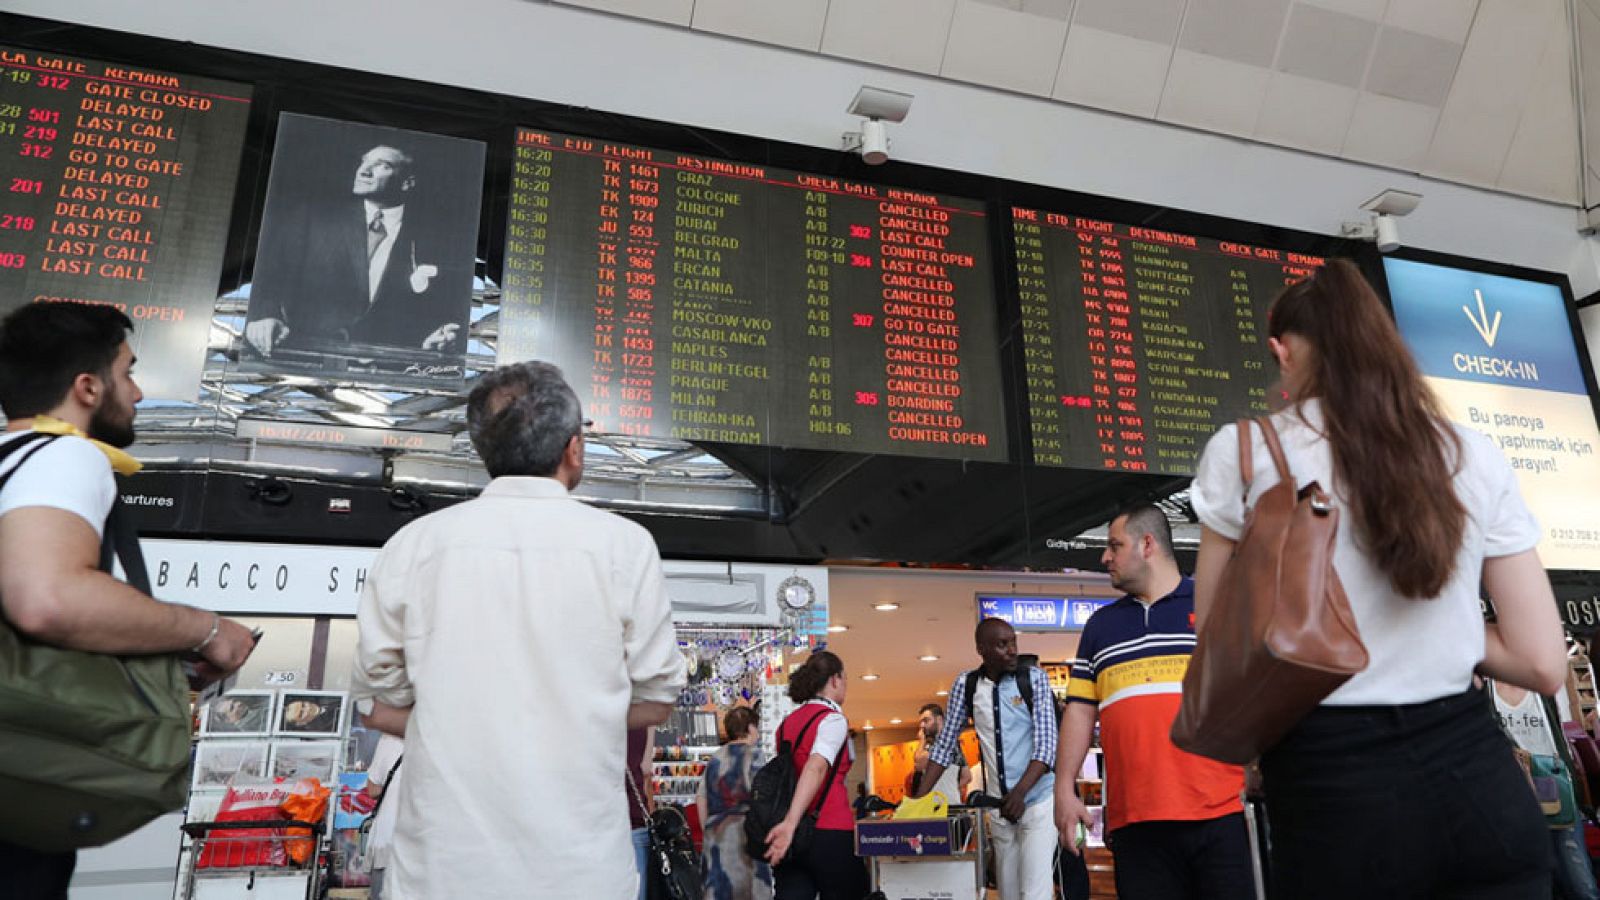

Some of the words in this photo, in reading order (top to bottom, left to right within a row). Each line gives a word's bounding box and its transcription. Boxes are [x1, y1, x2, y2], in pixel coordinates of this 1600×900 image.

[37, 74, 71, 90] 312
[85, 81, 134, 99] GATE
[140, 90, 212, 111] CLOSED
[80, 98, 164, 122] DELAYED
[23, 125, 58, 141] 219
[72, 132, 156, 155] DELAYED
[76, 115, 125, 133] LAST
[131, 124, 177, 141] CALL
[20, 143, 53, 160] 312
[69, 150, 98, 164] GO
[103, 155, 129, 169] TO
[135, 159, 183, 176] GATE
[9, 178, 43, 194] 201
[59, 184, 111, 202] LAST
[115, 192, 162, 209] CALL
[64, 166, 150, 189] DELAYED
[516, 146, 552, 162] 16:20
[602, 159, 621, 173] TK
[629, 164, 660, 179] 1461
[676, 171, 713, 187] GRAZ
[879, 202, 949, 222] CANCELLED
[55, 202, 142, 225] DELAYED
[513, 177, 550, 193] 16:20
[601, 189, 620, 202] TK
[676, 201, 725, 218] ZURICH
[880, 229, 912, 245] LAST
[914, 235, 945, 249] CALL
[515, 161, 551, 177] 16:20
[602, 174, 620, 188] TK
[629, 178, 659, 194] 1673
[675, 187, 742, 207] COLOGNE
[879, 216, 950, 236] CANCELLED
[0, 214, 35, 231] 218
[51, 220, 103, 239] LAST
[107, 228, 154, 245] CALL
[600, 204, 619, 219] EK
[675, 215, 718, 233] DUBAI
[881, 244, 939, 262] COUNTER
[941, 253, 974, 268] OPEN
[1011, 206, 1038, 221] TIME
[1046, 213, 1069, 226] ETD
[1075, 218, 1114, 233] FLIGHT
[1129, 226, 1196, 247] DESTINATION
[1219, 242, 1251, 255] CHECK
[1254, 248, 1280, 261] GATE
[46, 238, 100, 258] LAST
[103, 245, 150, 263] CALL
[599, 220, 618, 233] JU
[629, 224, 654, 238] 553
[674, 231, 740, 250] BELGRAD
[880, 258, 912, 274] LAST
[916, 263, 948, 278] CALL
[41, 257, 95, 276] LAST
[99, 263, 147, 281] CALL
[598, 251, 617, 265] TK
[673, 262, 721, 278] ERCAN
[882, 288, 955, 307] CANCELLED
[673, 246, 721, 263] MALTA
[881, 274, 954, 293] CANCELLED
[596, 283, 615, 297] TK
[852, 313, 875, 328] 307
[884, 318, 904, 332] GO
[907, 320, 925, 333] TO
[927, 323, 961, 338] GATE
[598, 267, 616, 282] TK
[625, 271, 656, 286] 1395
[673, 277, 735, 296] CATANIA
[883, 302, 956, 321] CANCELLED
[133, 304, 185, 322] OPEN
[594, 333, 613, 347] TK
[622, 337, 655, 351] 1453
[671, 341, 728, 359] NAPLES
[885, 364, 960, 382] CANCELLED
[671, 326, 767, 346] CASABLANCA
[885, 348, 960, 367] CANCELLED
[884, 332, 959, 351] CANCELLED
[592, 349, 612, 364] TK
[621, 352, 654, 368] 1723
[886, 378, 961, 398] CANCELLED
[1452, 352, 1539, 381] CHECK-IN
[620, 387, 654, 403] 1875
[670, 390, 717, 408] MILAN
[888, 410, 963, 428] CANCELLED
[670, 375, 729, 392] PRAGUE
[854, 391, 879, 406] 305
[887, 395, 954, 412] BOARDING
[670, 408, 756, 428] TEHRAN-IKA
[888, 427, 950, 443] COUNTER
[952, 431, 988, 446] OPEN
[1468, 406, 1490, 424] Bu
[1493, 412, 1545, 431] panoya
[670, 427, 761, 445] AMSTERDAM
[1497, 433, 1567, 453] yaptırmak
[1568, 437, 1593, 457] için
[121, 493, 174, 507] artures
[157, 561, 289, 591] BACCO
[328, 566, 368, 594] SH
[982, 600, 999, 610] WC
